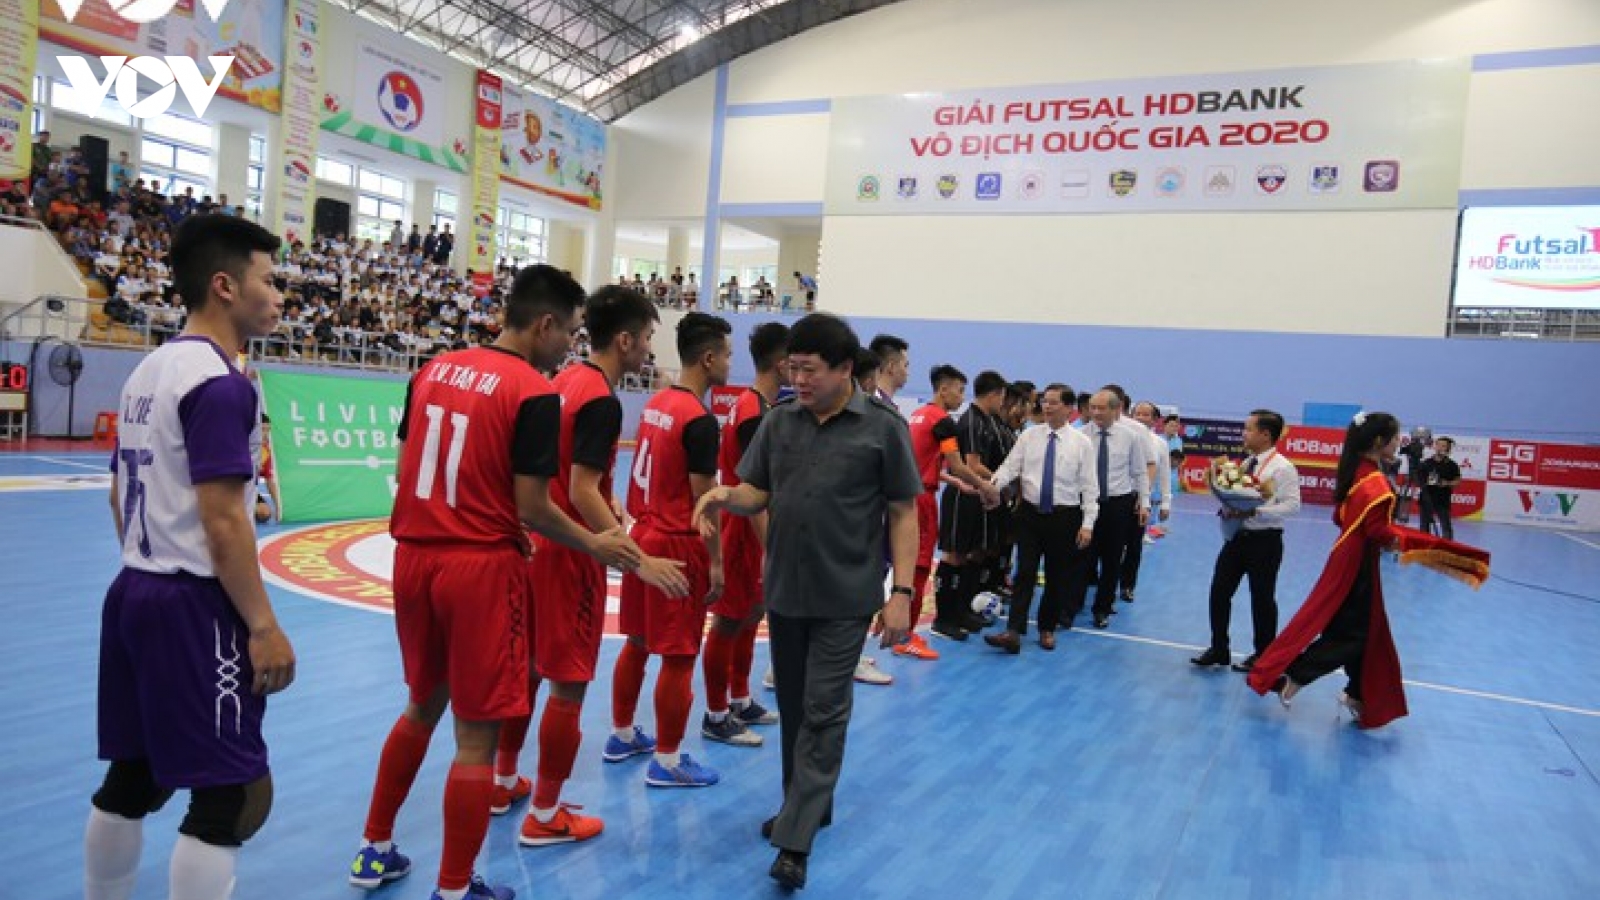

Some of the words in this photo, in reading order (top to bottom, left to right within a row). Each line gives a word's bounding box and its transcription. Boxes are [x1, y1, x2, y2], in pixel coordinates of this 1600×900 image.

[1003, 96, 1134, 123] FUTSAL
[1143, 85, 1306, 116] HDBANK
[910, 131, 954, 157] VÔ
[959, 132, 1034, 160] ĐỊCH
[1042, 120, 1141, 153] QUỐC
[1148, 125, 1210, 148] GIA
[1218, 119, 1330, 146] 2020
[1497, 233, 1587, 255] Futsal
[1469, 256, 1541, 270] HDBank
[290, 400, 404, 425] LIVIN
[293, 427, 401, 449] FOOTB
[415, 403, 470, 508] 11
[632, 437, 652, 505] 4
